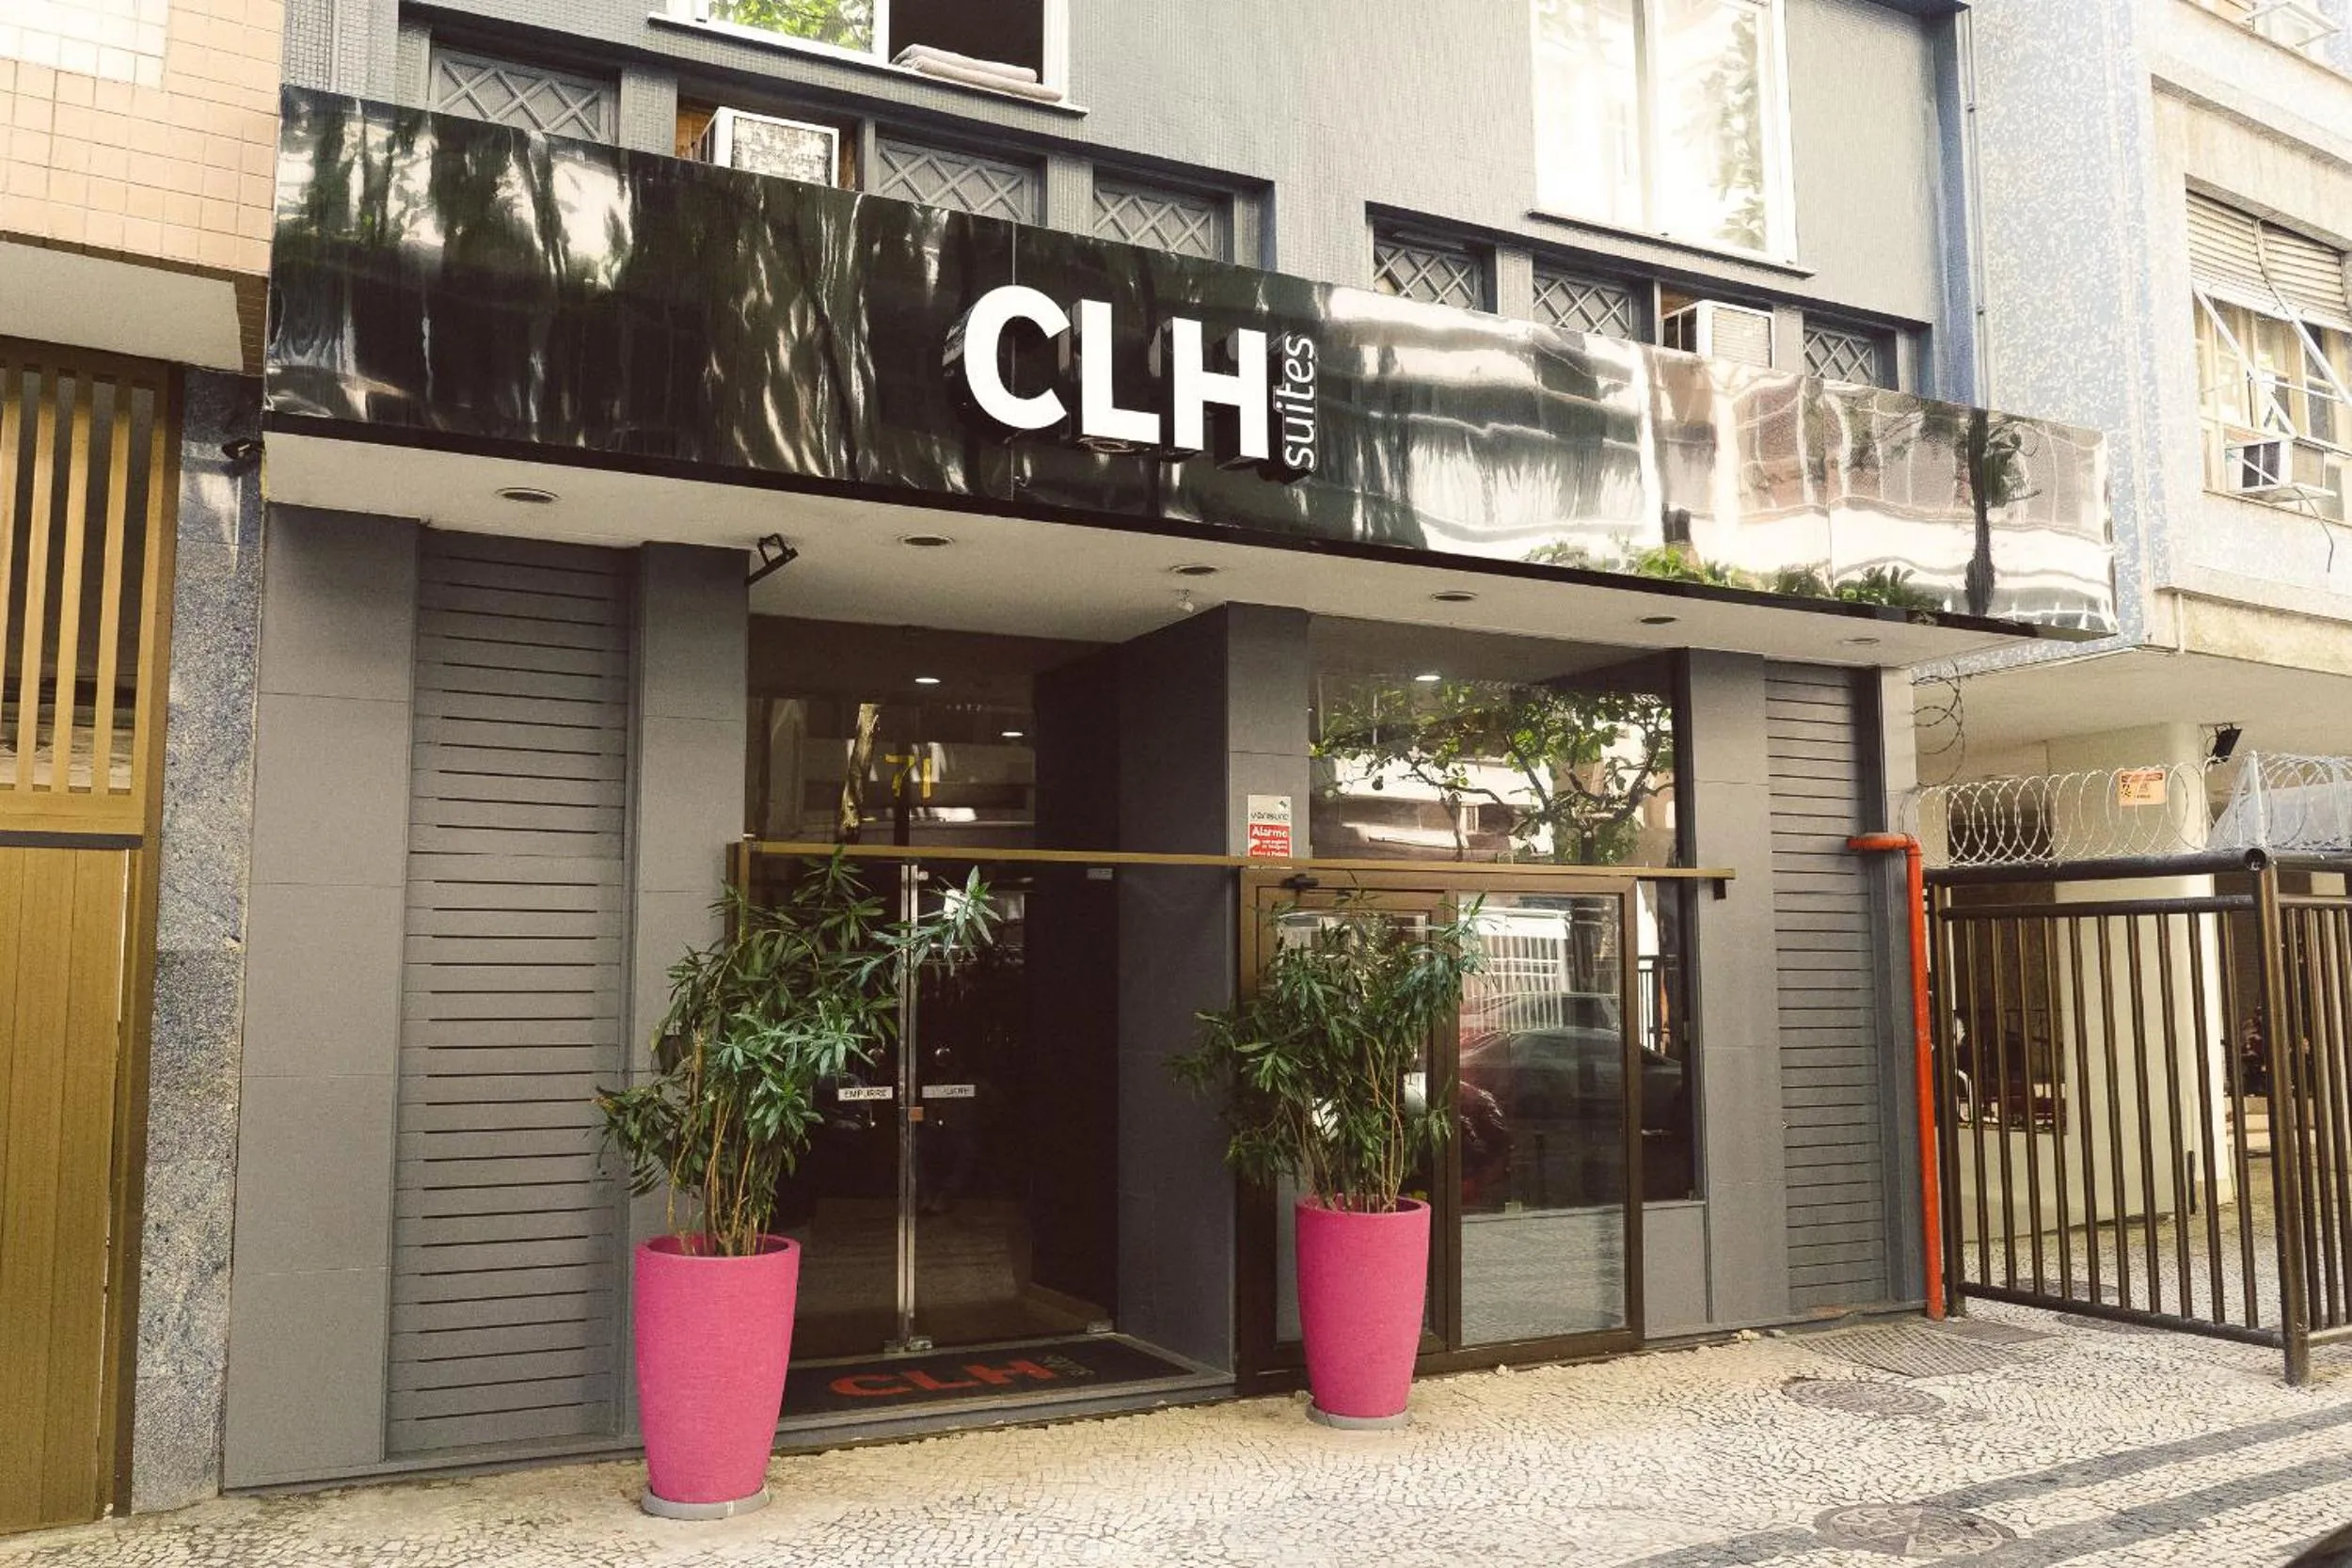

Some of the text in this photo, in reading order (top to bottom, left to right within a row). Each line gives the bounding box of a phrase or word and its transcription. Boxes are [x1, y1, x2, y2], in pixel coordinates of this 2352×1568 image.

[962, 284, 1270, 461] CLH
[1274, 333, 1315, 470] suites
[830, 1359, 1057, 1396] CLH
